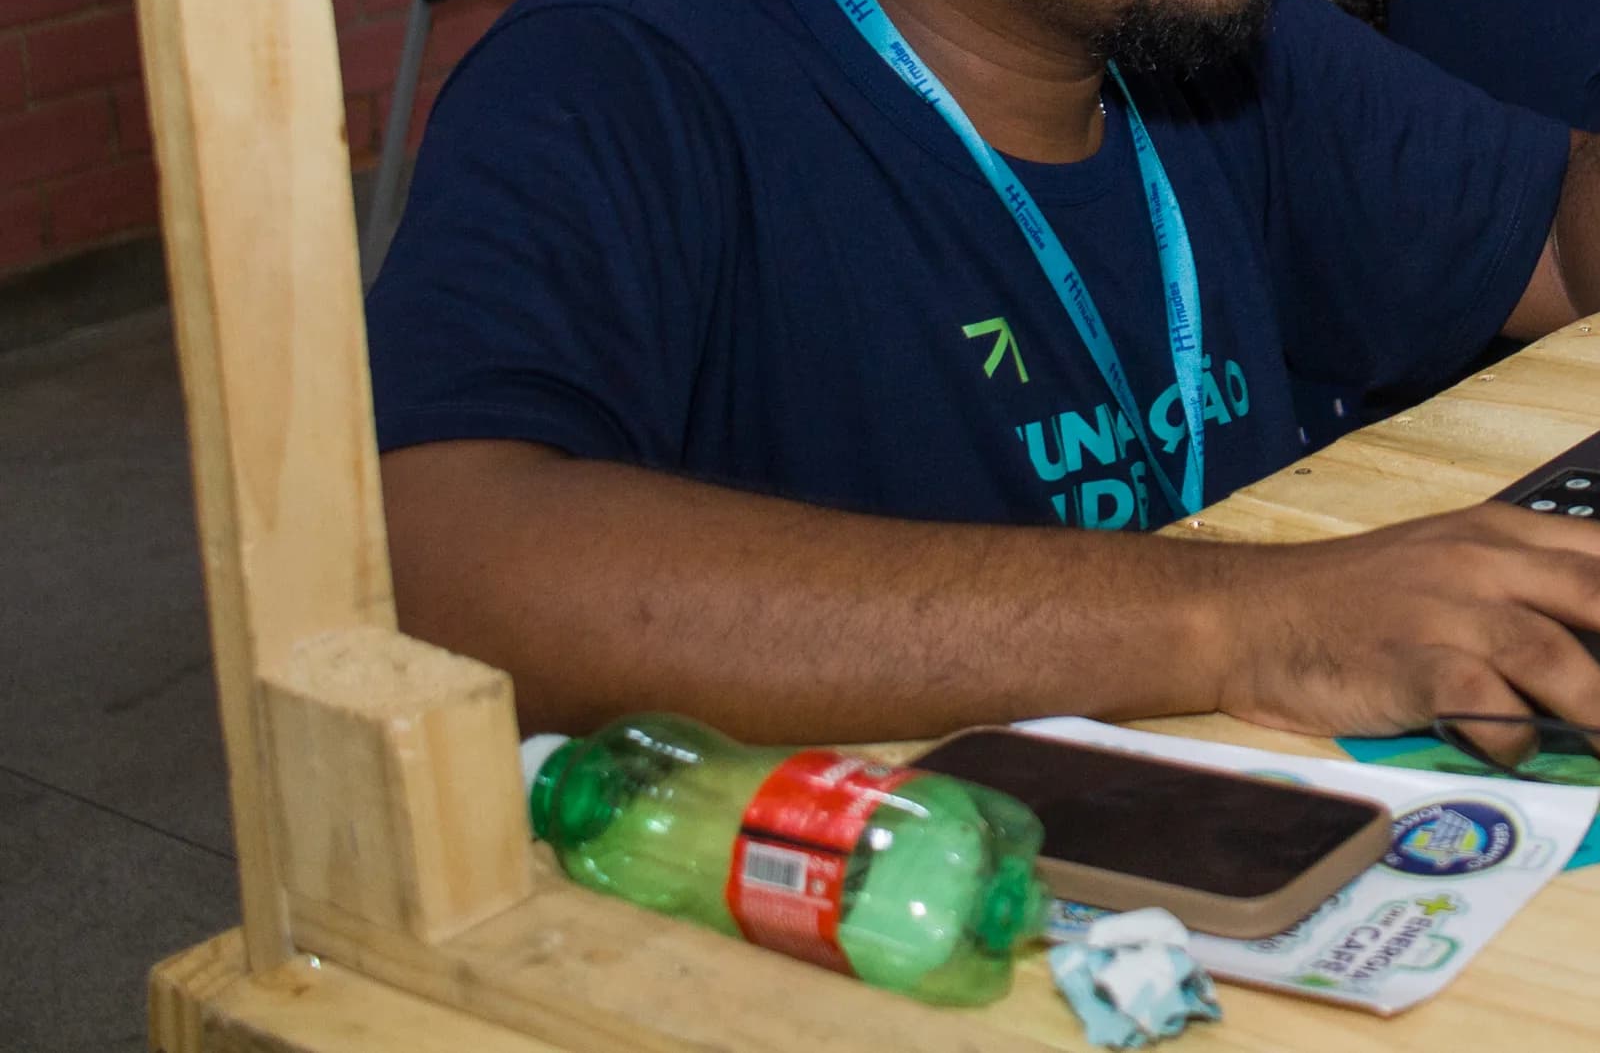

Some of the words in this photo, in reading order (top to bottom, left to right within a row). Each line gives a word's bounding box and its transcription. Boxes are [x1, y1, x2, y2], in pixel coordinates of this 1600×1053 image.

[889, 40, 924, 81] mudes
[1170, 281, 1190, 324] mudes
[1466, 822, 1510, 868] GERANDO
[1346, 915, 1433, 981] ENERGIA
